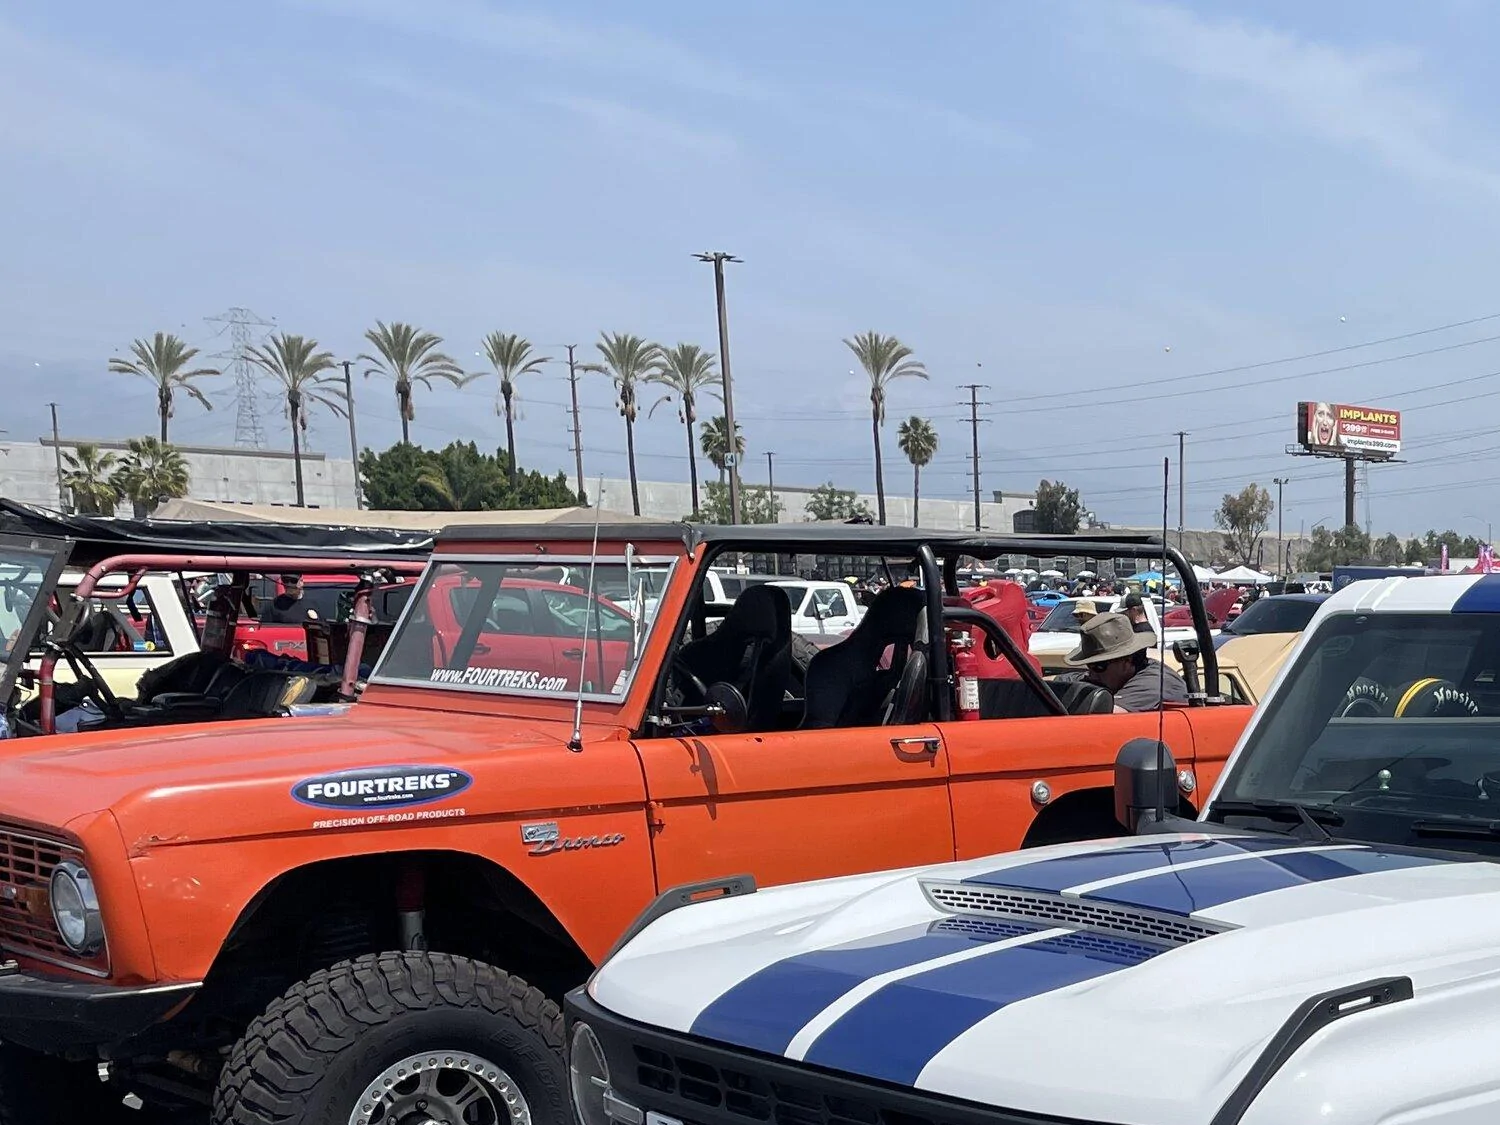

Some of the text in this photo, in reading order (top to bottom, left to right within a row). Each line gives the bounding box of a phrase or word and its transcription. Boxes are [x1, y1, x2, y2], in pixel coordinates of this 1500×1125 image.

[1340, 408, 1397, 425] IMPLANTS
[429, 666, 568, 692] www.FOURTREKS.com
[312, 807, 466, 830] PRECISION OFF-ROAD PRODUCTS
